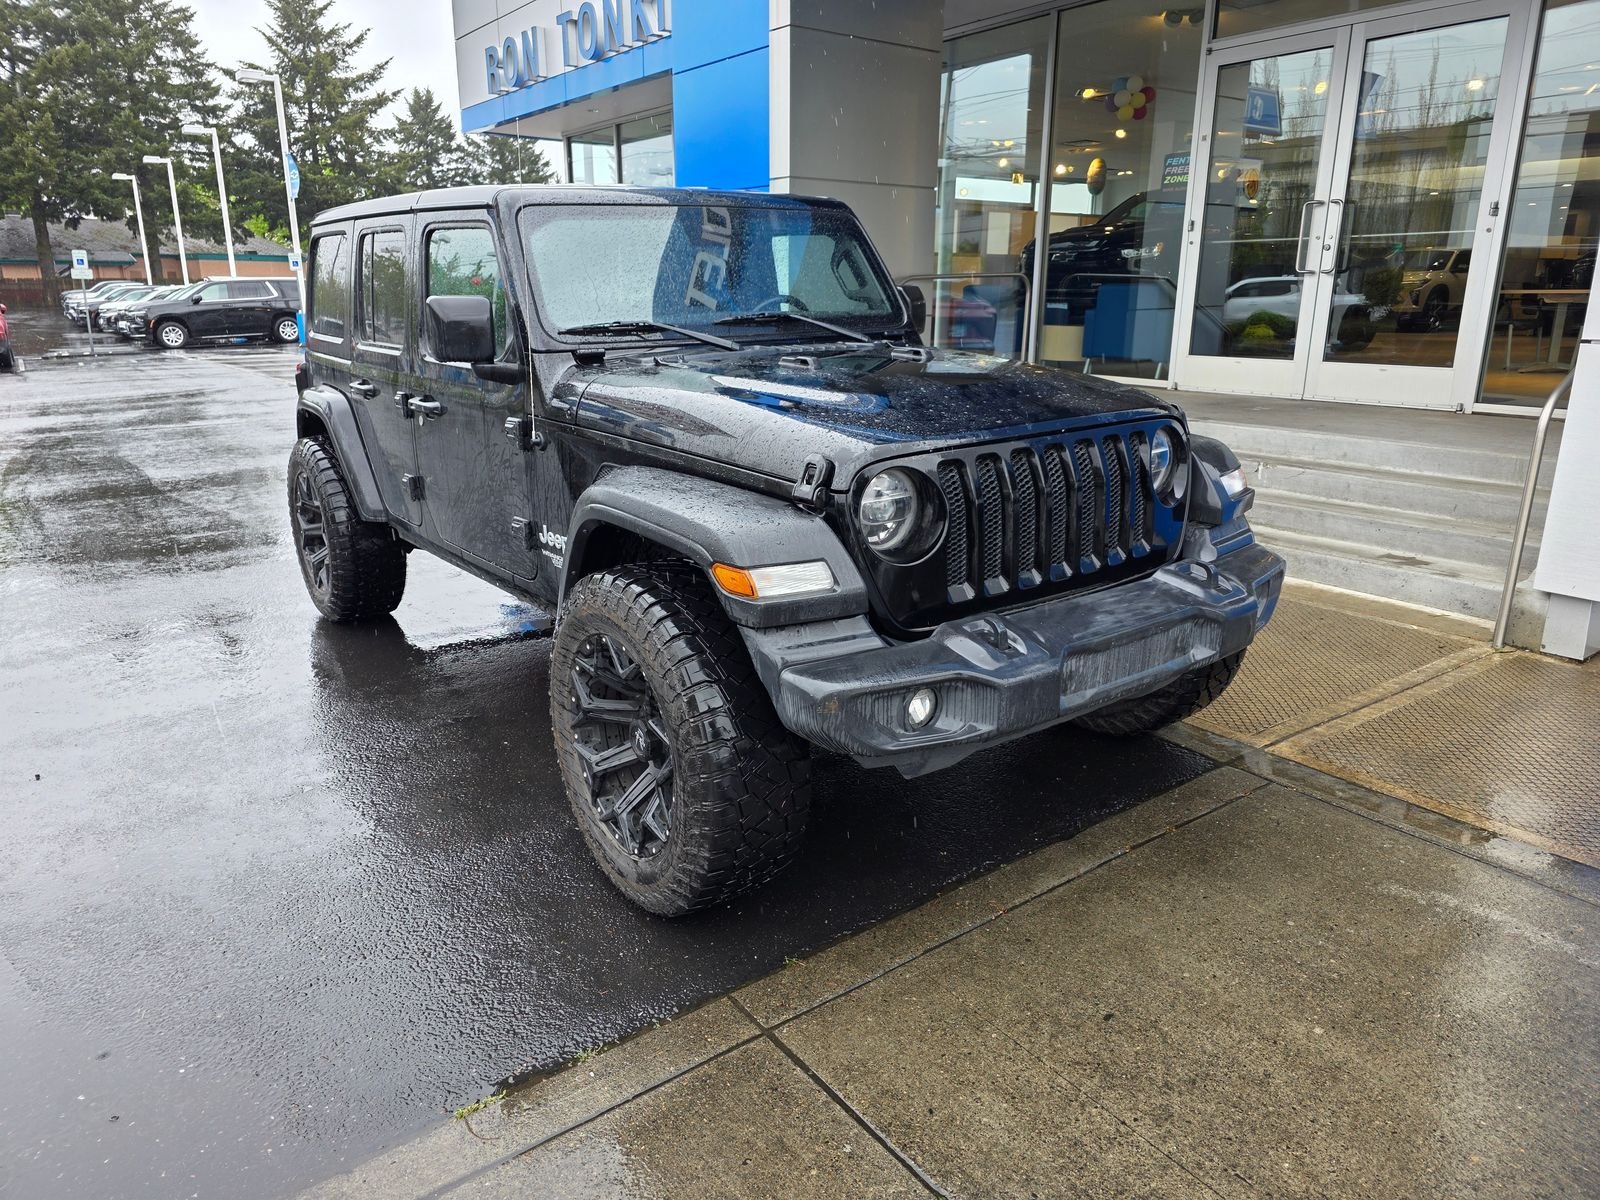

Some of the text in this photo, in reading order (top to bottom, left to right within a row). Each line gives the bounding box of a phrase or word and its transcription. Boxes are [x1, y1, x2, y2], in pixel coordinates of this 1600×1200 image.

[485, 26, 540, 95] RON
[1165, 165, 1190, 175] FREE
[1163, 174, 1190, 184] ZONE
